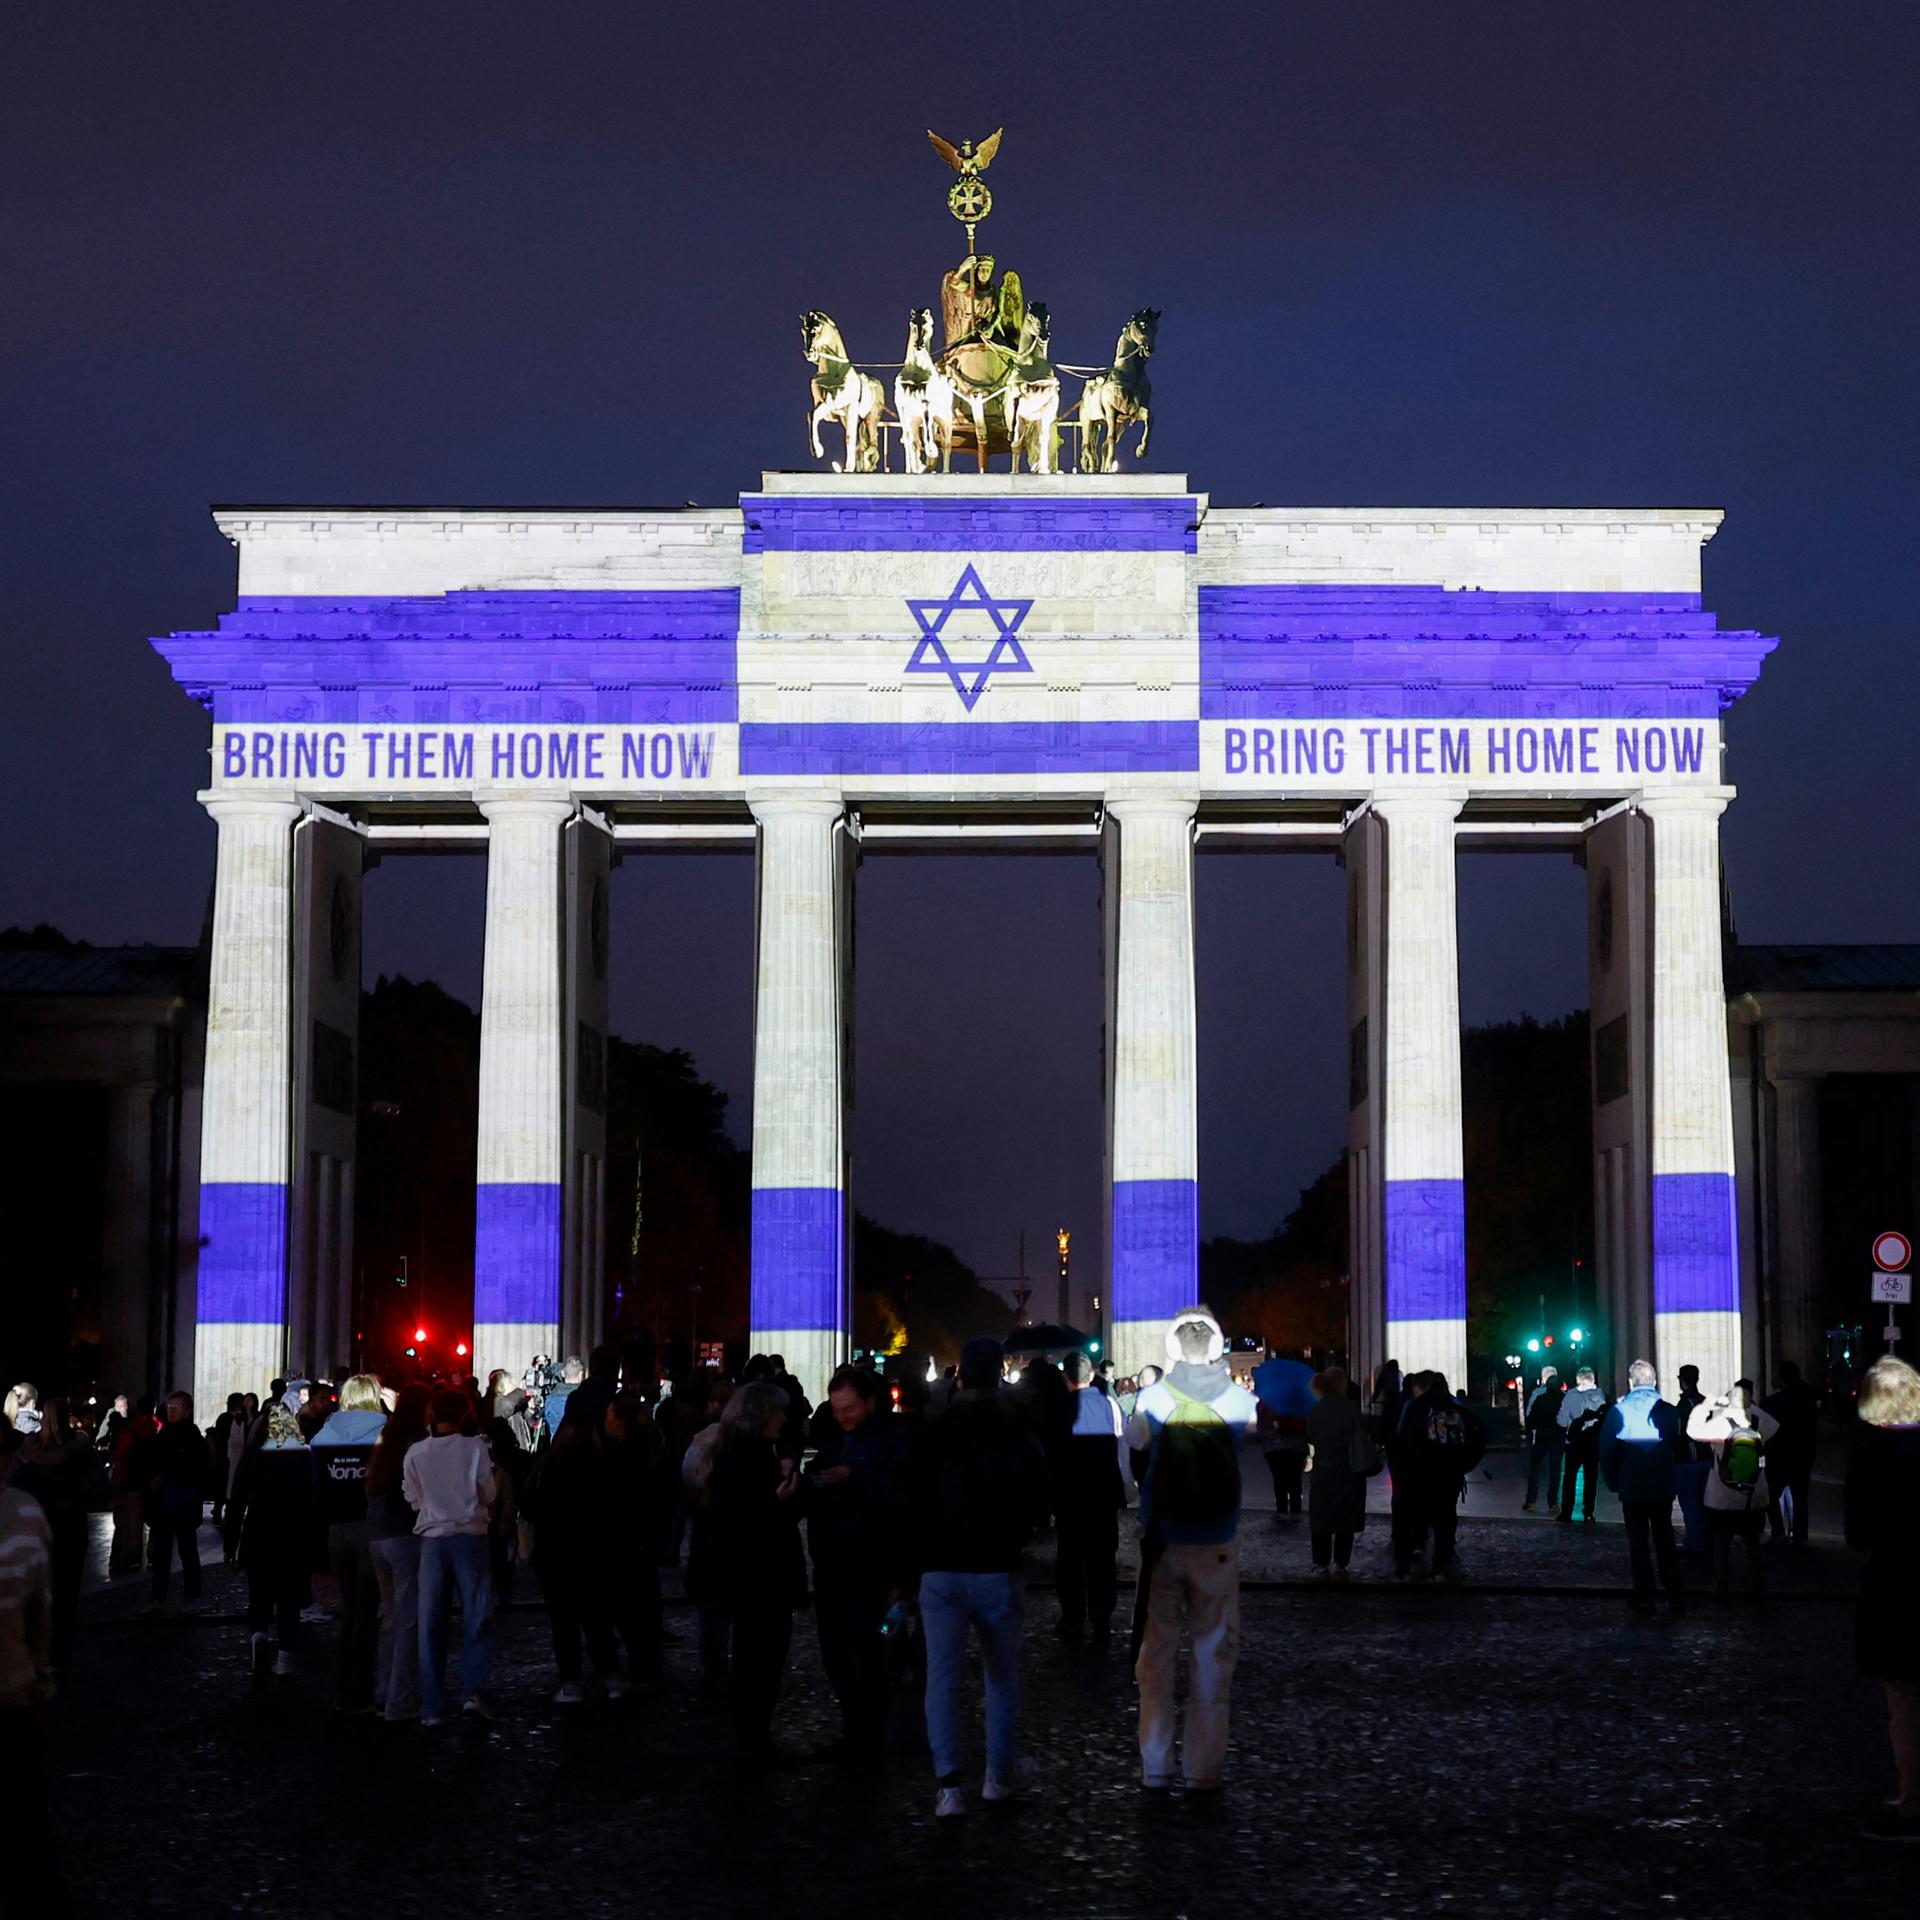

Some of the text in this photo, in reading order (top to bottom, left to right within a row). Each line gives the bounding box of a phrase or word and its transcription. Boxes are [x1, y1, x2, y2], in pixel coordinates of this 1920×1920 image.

[223, 731, 715, 779] BRING THEM HOME NOW
[1224, 726, 1705, 775] BRING THEM HOME NOW
